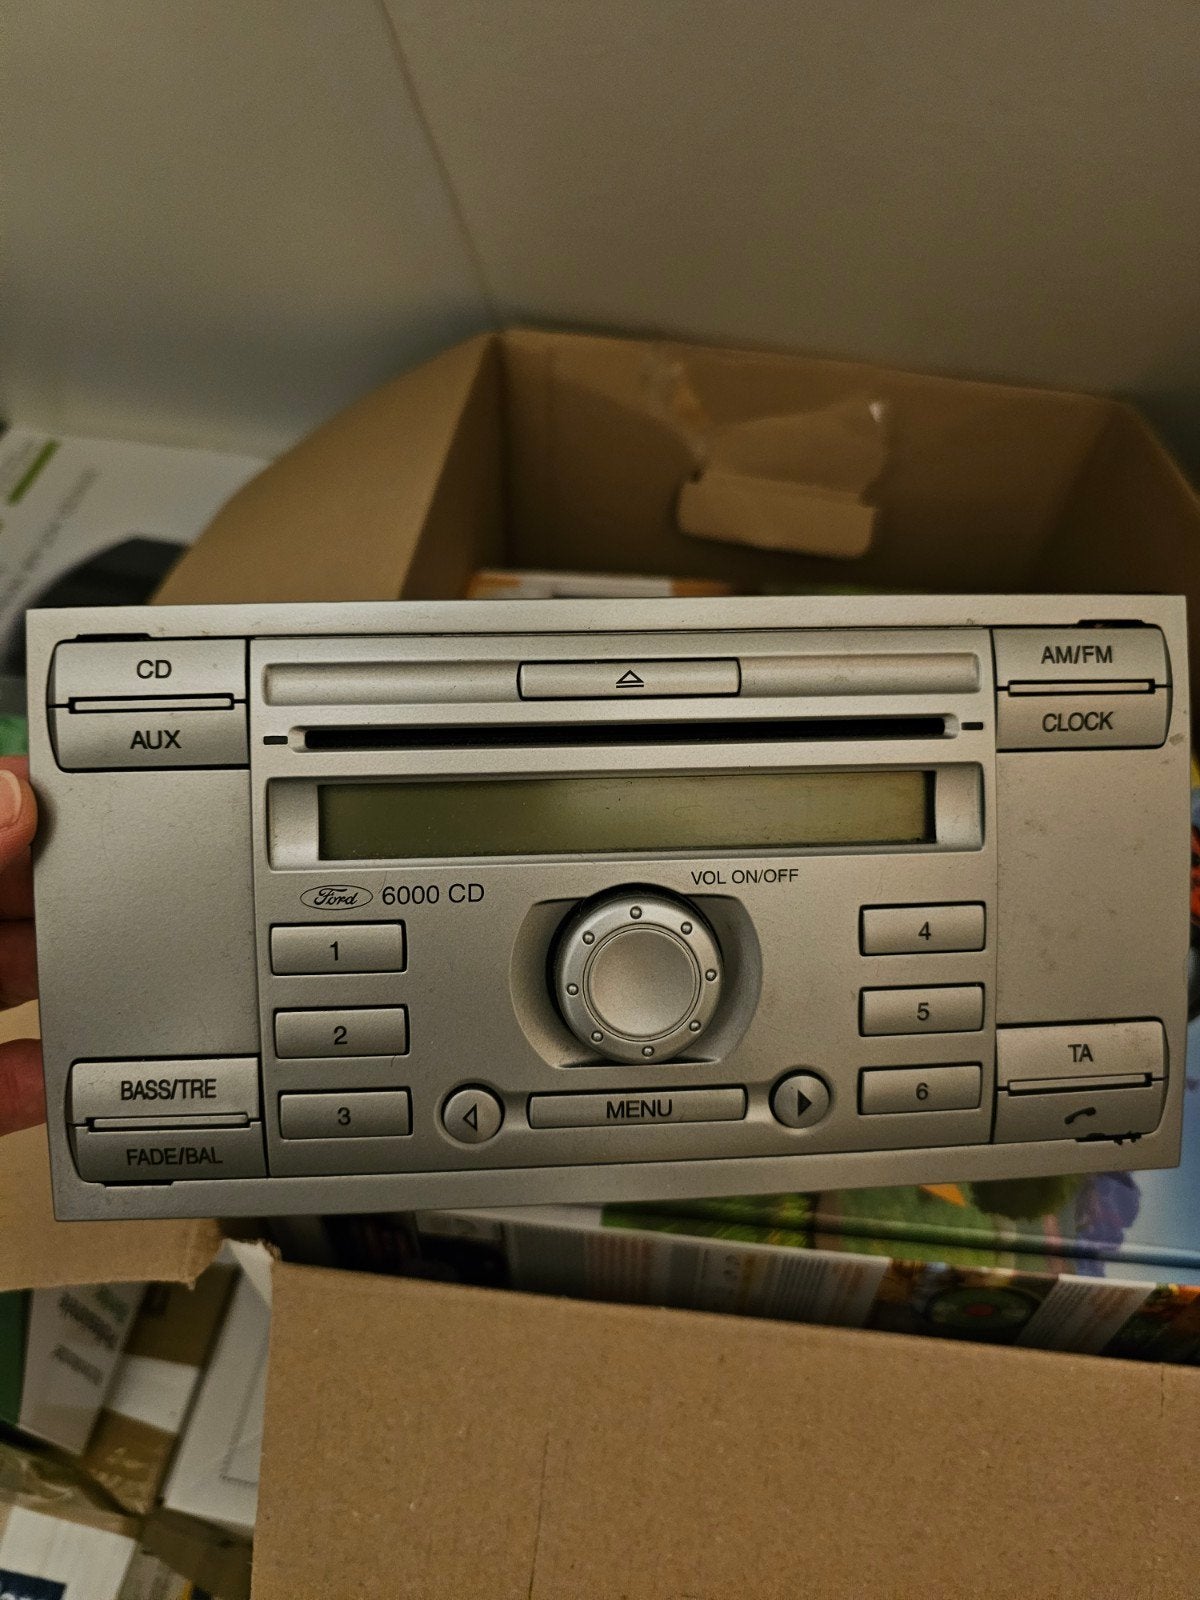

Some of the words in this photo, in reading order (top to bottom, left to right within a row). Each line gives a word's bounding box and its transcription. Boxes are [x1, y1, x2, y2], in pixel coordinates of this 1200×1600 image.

[1041, 645, 1113, 664] AM/FM
[136, 659, 172, 679] CD
[1042, 711, 1113, 732] CLOCK
[130, 730, 181, 750] AUX
[691, 869, 726, 886] VOL
[731, 868, 800, 885] ON/OFF
[381, 884, 440, 905] 6000
[448, 883, 485, 904] CD
[917, 922, 932, 941] 4
[330, 941, 340, 961] 1
[916, 1002, 930, 1021] 5
[333, 1025, 348, 1046] 2
[1067, 1043, 1093, 1064] TA
[120, 1079, 217, 1101] BASS/TRE
[915, 1082, 929, 1101] 6
[337, 1107, 351, 1126] 3
[606, 1099, 673, 1119] MENU
[126, 1147, 223, 1167] FADE/BAL
